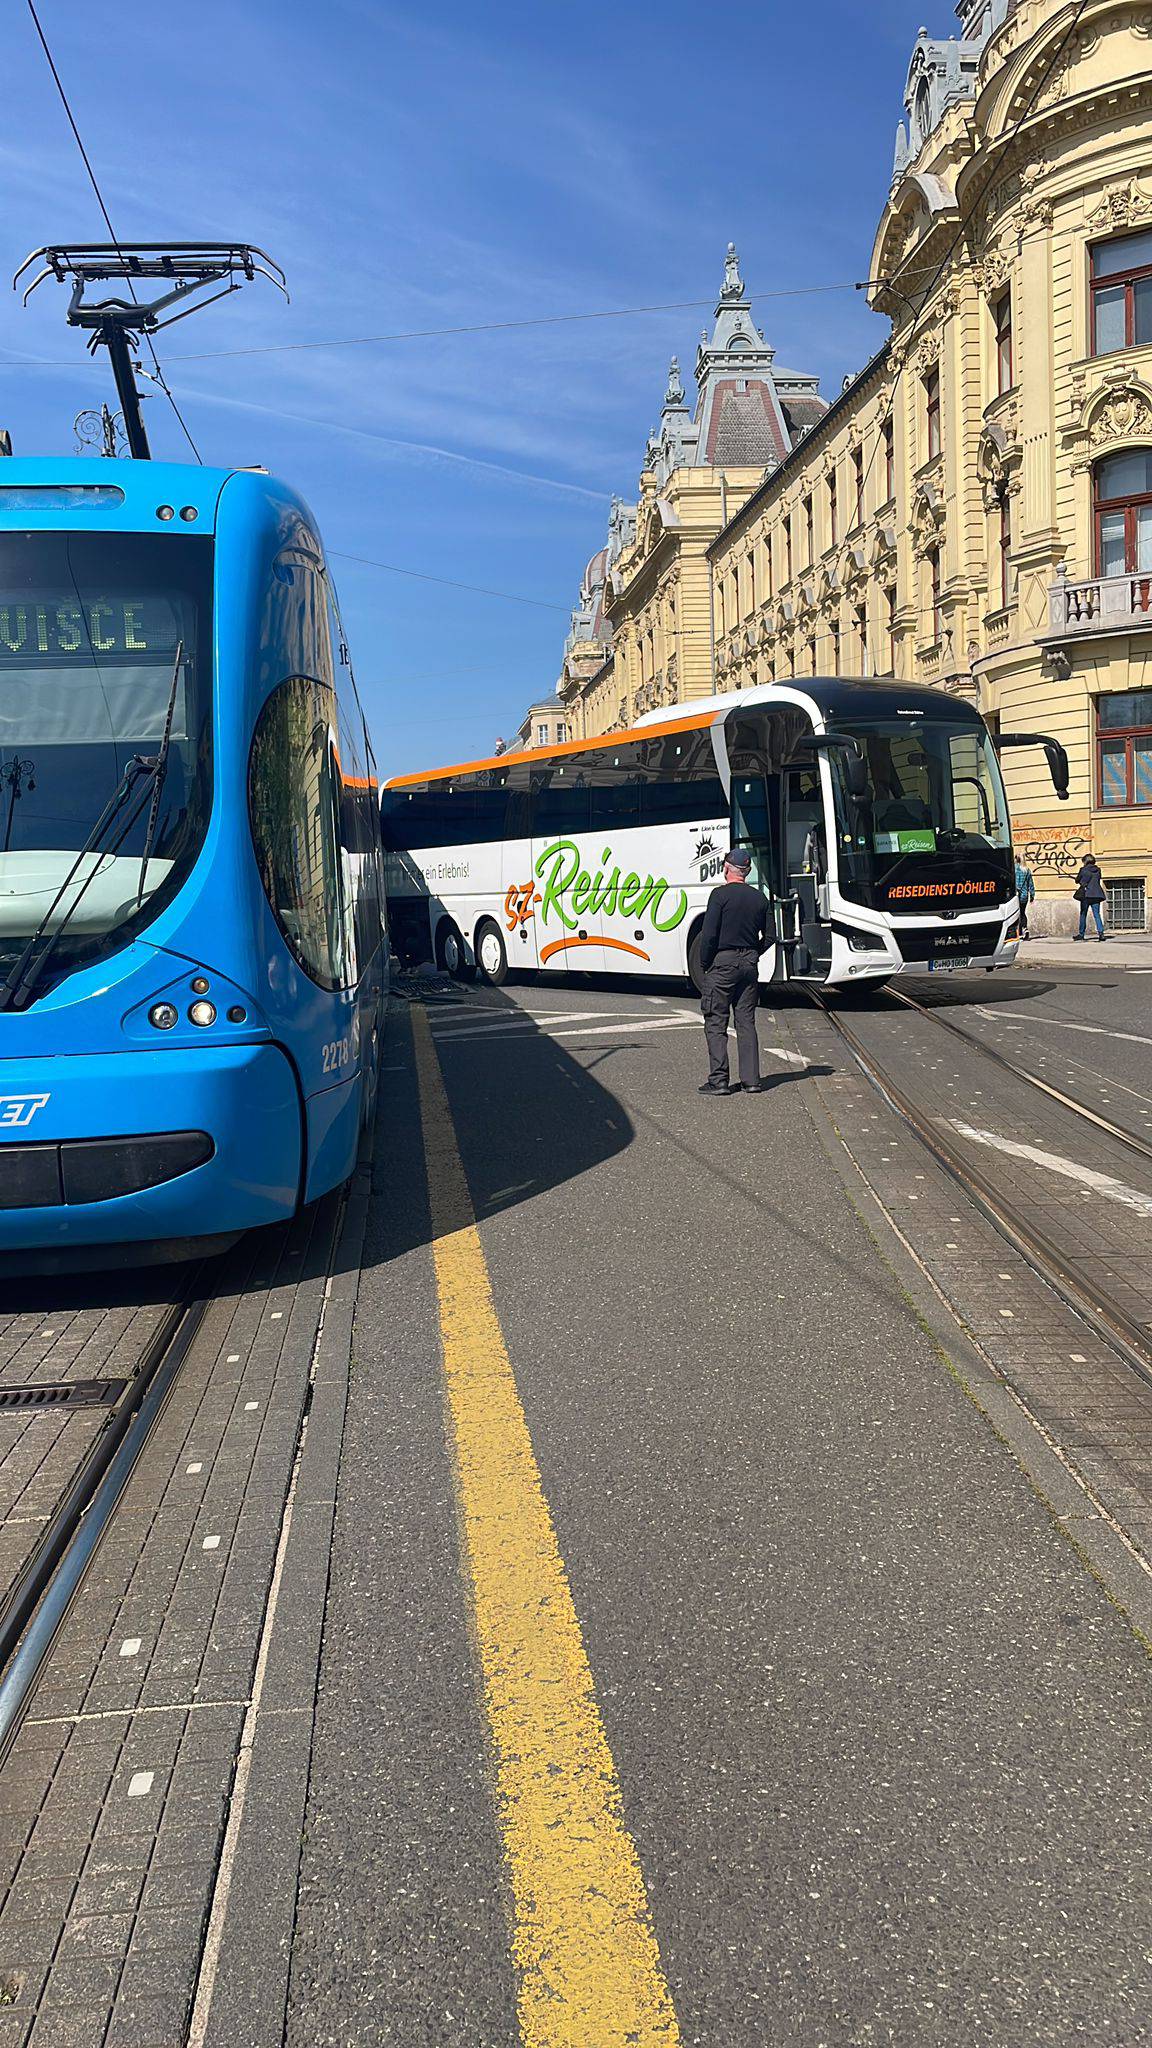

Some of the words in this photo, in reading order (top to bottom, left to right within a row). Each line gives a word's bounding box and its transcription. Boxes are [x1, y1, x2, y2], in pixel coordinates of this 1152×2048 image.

[425, 866, 437, 880] ein
[438, 862, 469, 879] Erlebnis!
[700, 856, 724, 883] Döh
[888, 883, 955, 899] REISEDIENST
[956, 880, 996, 895] DÖHLER
[934, 935, 969, 947] MAN
[322, 1037, 348, 1073] 2278
